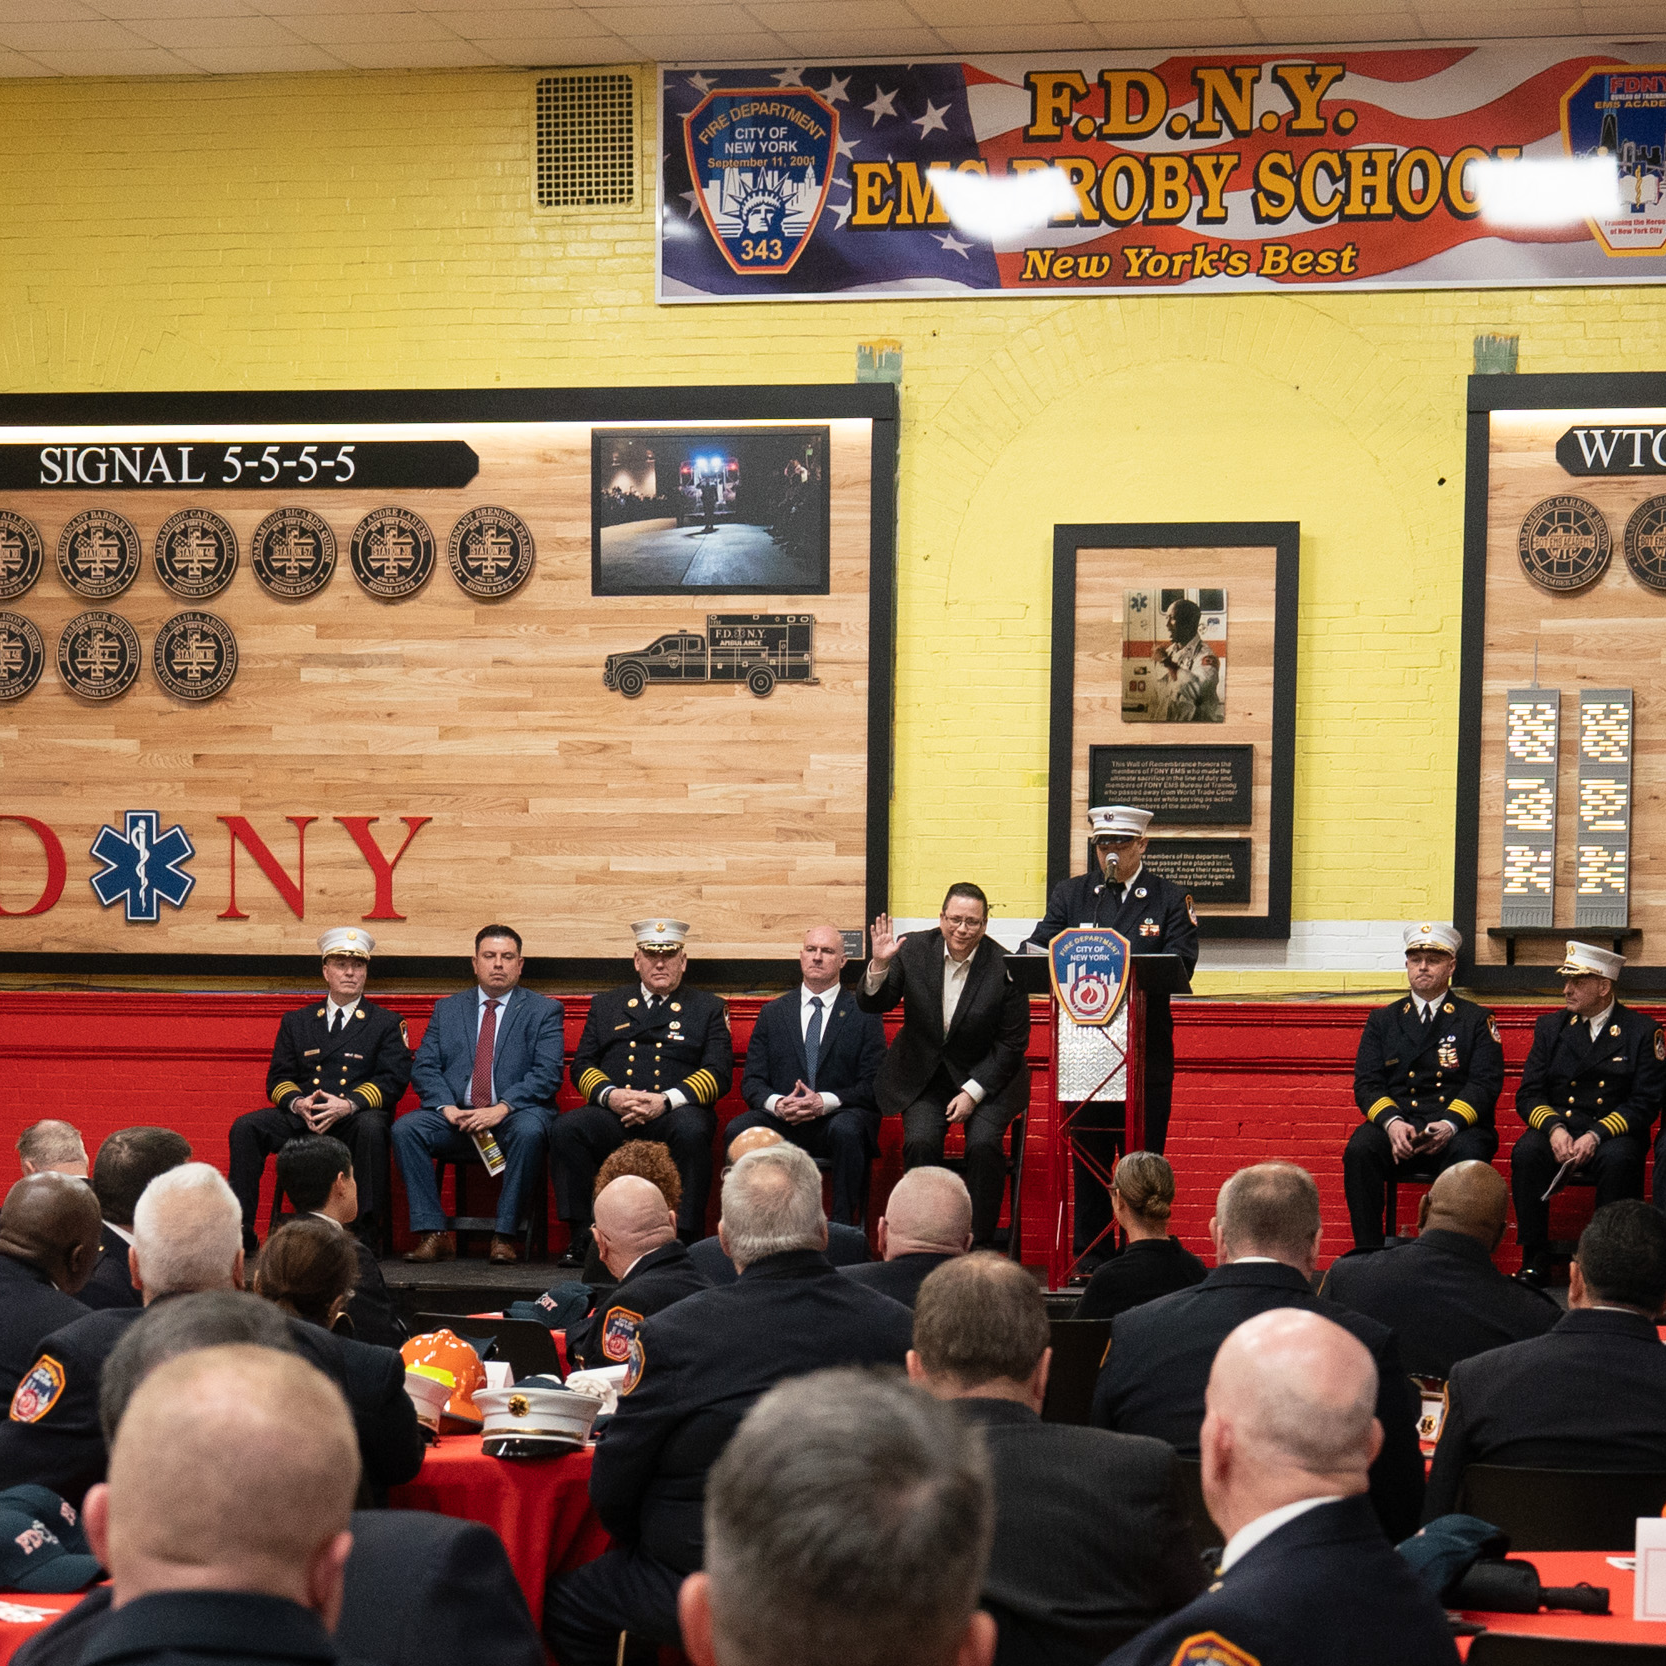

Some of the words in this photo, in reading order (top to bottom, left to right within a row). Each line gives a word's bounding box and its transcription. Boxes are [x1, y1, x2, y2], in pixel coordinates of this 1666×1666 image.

[1025, 64, 1358, 141] F.D.N.Y.
[1594, 101, 1620, 109] EMS
[698, 114, 730, 145] FIRE
[730, 102, 826, 140] DEPARTMENT
[735, 127, 765, 139] CITY
[769, 127, 788, 138] OF
[707, 157, 768, 169] September
[772, 157, 787, 168] 11,
[790, 156, 816, 167] 2001
[724, 142, 757, 154] NEW
[759, 141, 798, 153] YORK
[1012, 152, 1239, 226] ROBY
[1255, 144, 1523, 224] SCHOO
[1605, 219, 1632, 228] Training
[1649, 227, 1663, 236] City
[741, 239, 783, 260] 343
[1020, 249, 1110, 281] New
[1123, 245, 1249, 280] York's
[1259, 242, 1358, 276] Best
[39, 447, 206, 485] SIGNAL
[222, 445, 357, 484] 5-5-5-5
[60, 512, 89, 567] LIEUTENANT
[90, 511, 129, 537] BARBARA
[156, 512, 188, 559] PARAMEDIC
[190, 510, 224, 533] CARLOS
[220, 529, 234, 559] LILLO
[254, 511, 284, 561] PARAMEDIC
[285, 509, 324, 530] RICARDO
[321, 530, 332, 563] QUINN
[353, 523, 367, 543] EMT
[367, 508, 398, 526] ANDRE
[399, 509, 430, 543] LAHENS
[448, 513, 474, 573] LIEUTENANT
[475, 508, 517, 527] BRENDON
[516, 526, 530, 572] PEARSON
[1520, 500, 1555, 551] PARAMEDIC
[1593, 512, 1608, 551] BROWN
[269, 581, 295, 594] SIGNAL
[63, 613, 108, 643] FREDERICK
[110, 613, 137, 664] WHITESIDE
[715, 629, 734, 639] F.D.
[747, 629, 766, 638] N.Y.
[155, 627, 170, 685] PARAMEDIC
[1059, 941, 1074, 956] FIRE
[1074, 935, 1121, 956] DEPARTMENT
